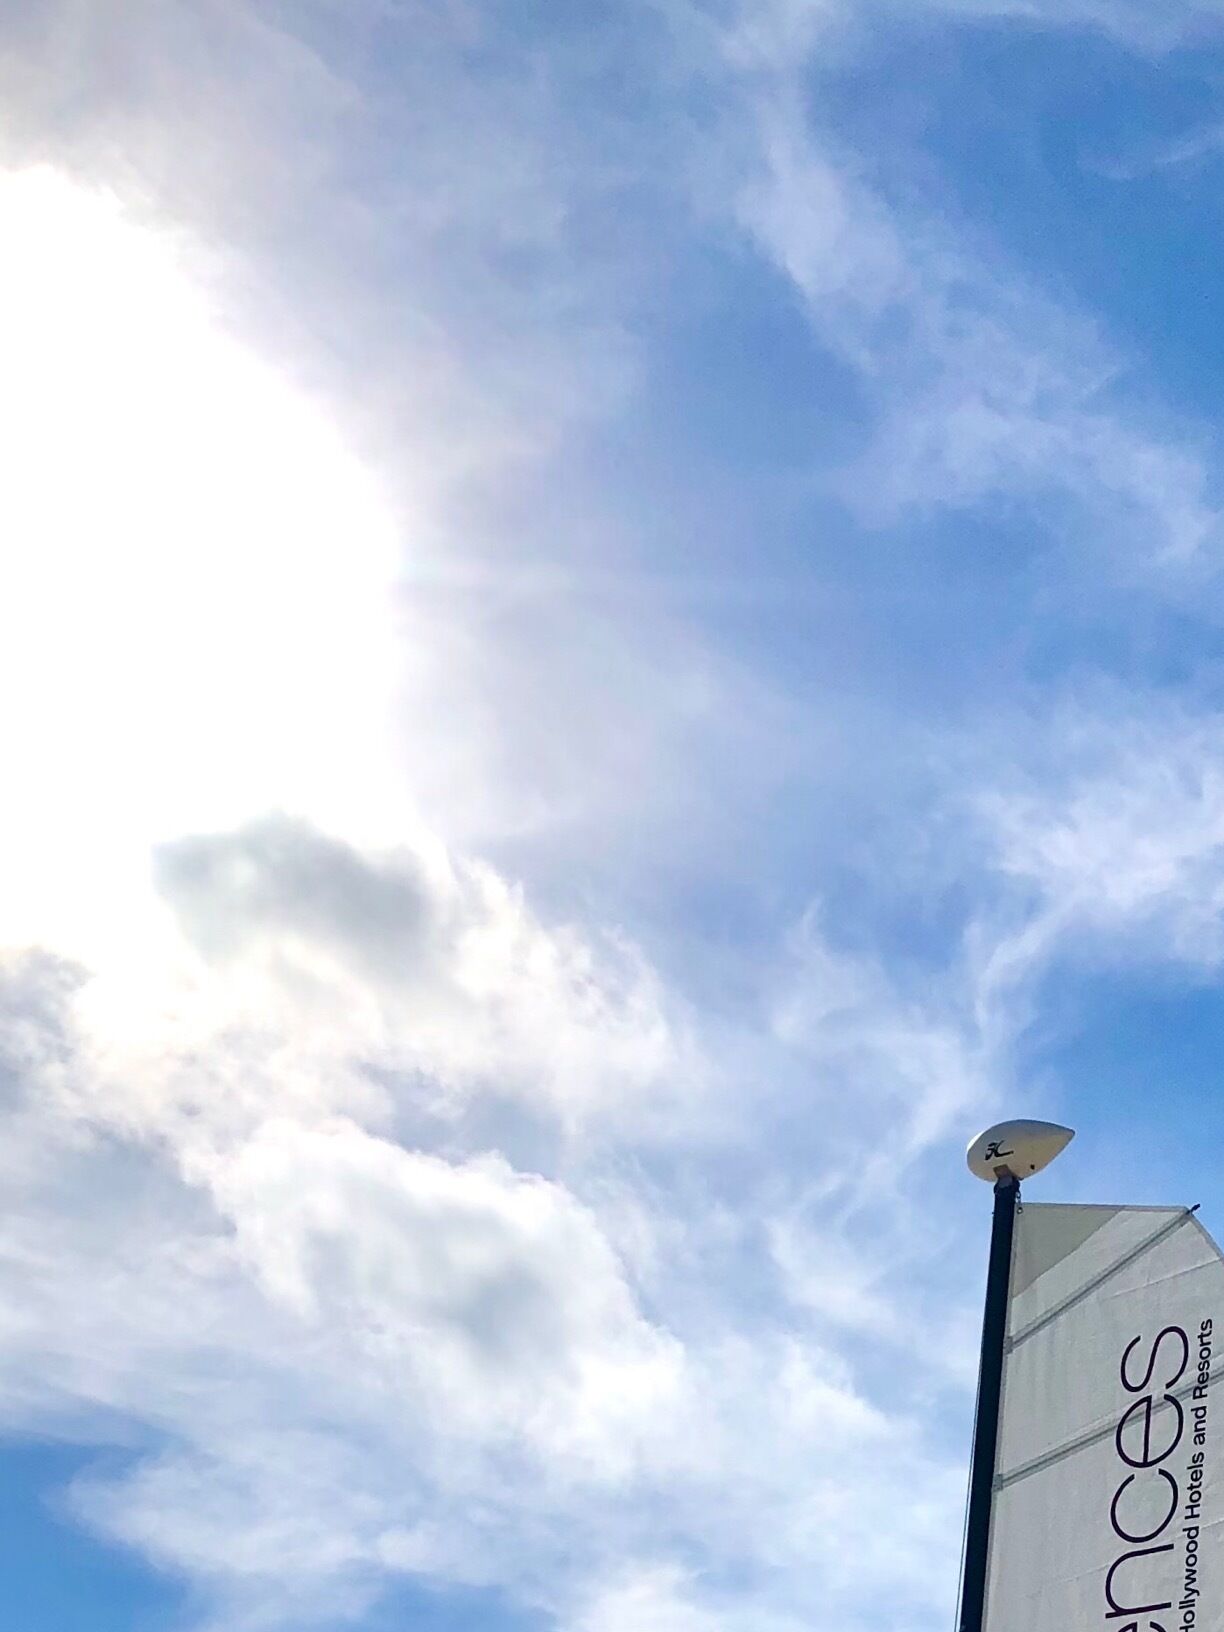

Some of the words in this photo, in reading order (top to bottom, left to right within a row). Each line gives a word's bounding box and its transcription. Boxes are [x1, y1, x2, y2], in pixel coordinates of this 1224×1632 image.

[1193, 1318, 1213, 1400] Resorts
[1190, 1405, 1208, 1446] and
[1185, 1451, 1205, 1520] Hotels
